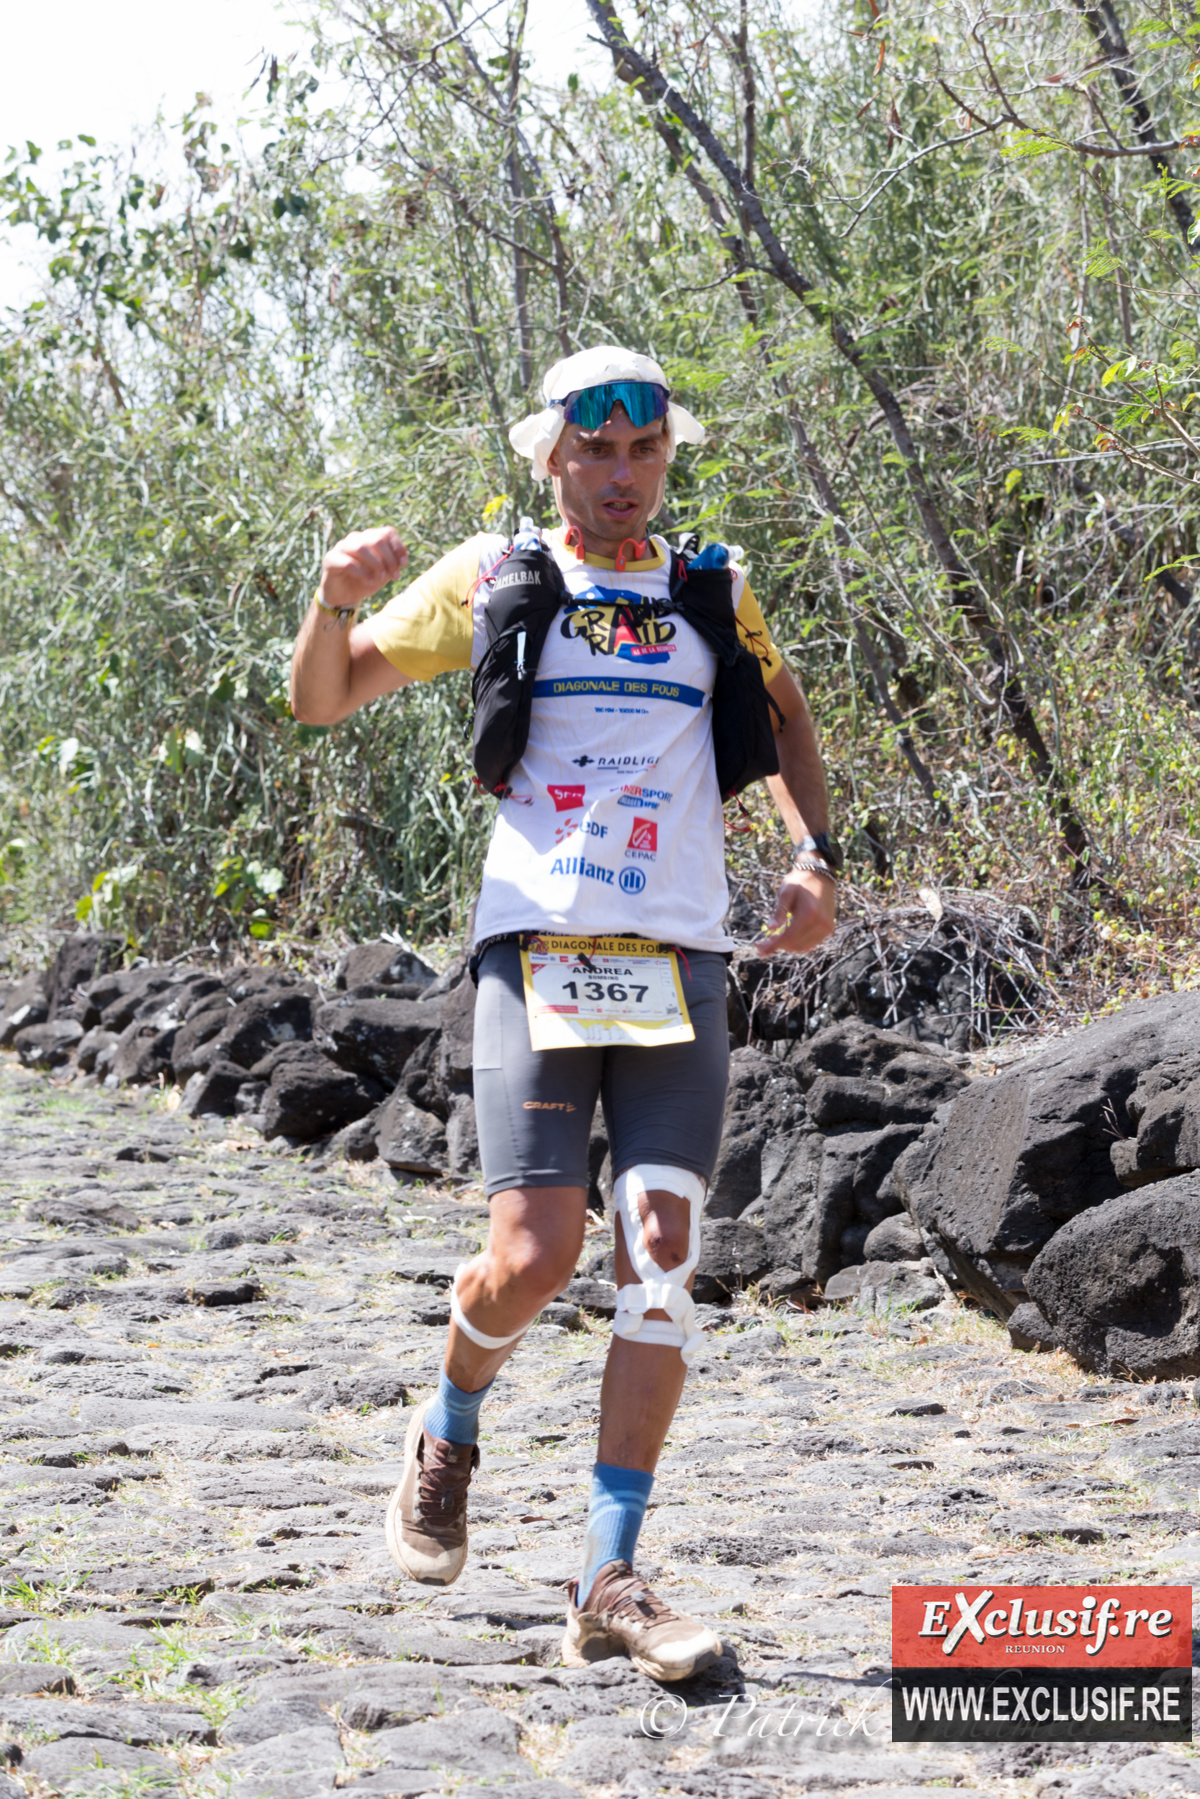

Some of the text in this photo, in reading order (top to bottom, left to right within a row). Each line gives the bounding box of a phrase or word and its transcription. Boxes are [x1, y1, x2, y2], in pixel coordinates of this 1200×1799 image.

[553, 677, 680, 697] DIAGONALE DES FOUS
[624, 848, 657, 862] CEPAC
[550, 857, 615, 886] Allianz
[551, 940, 614, 951] DIAGONALE
[618, 942, 637, 952] DES
[641, 944, 669, 954] FOU
[572, 966, 634, 976] ANDREA
[562, 981, 649, 1003] 1367
[523, 1101, 566, 1111] CRAFT
